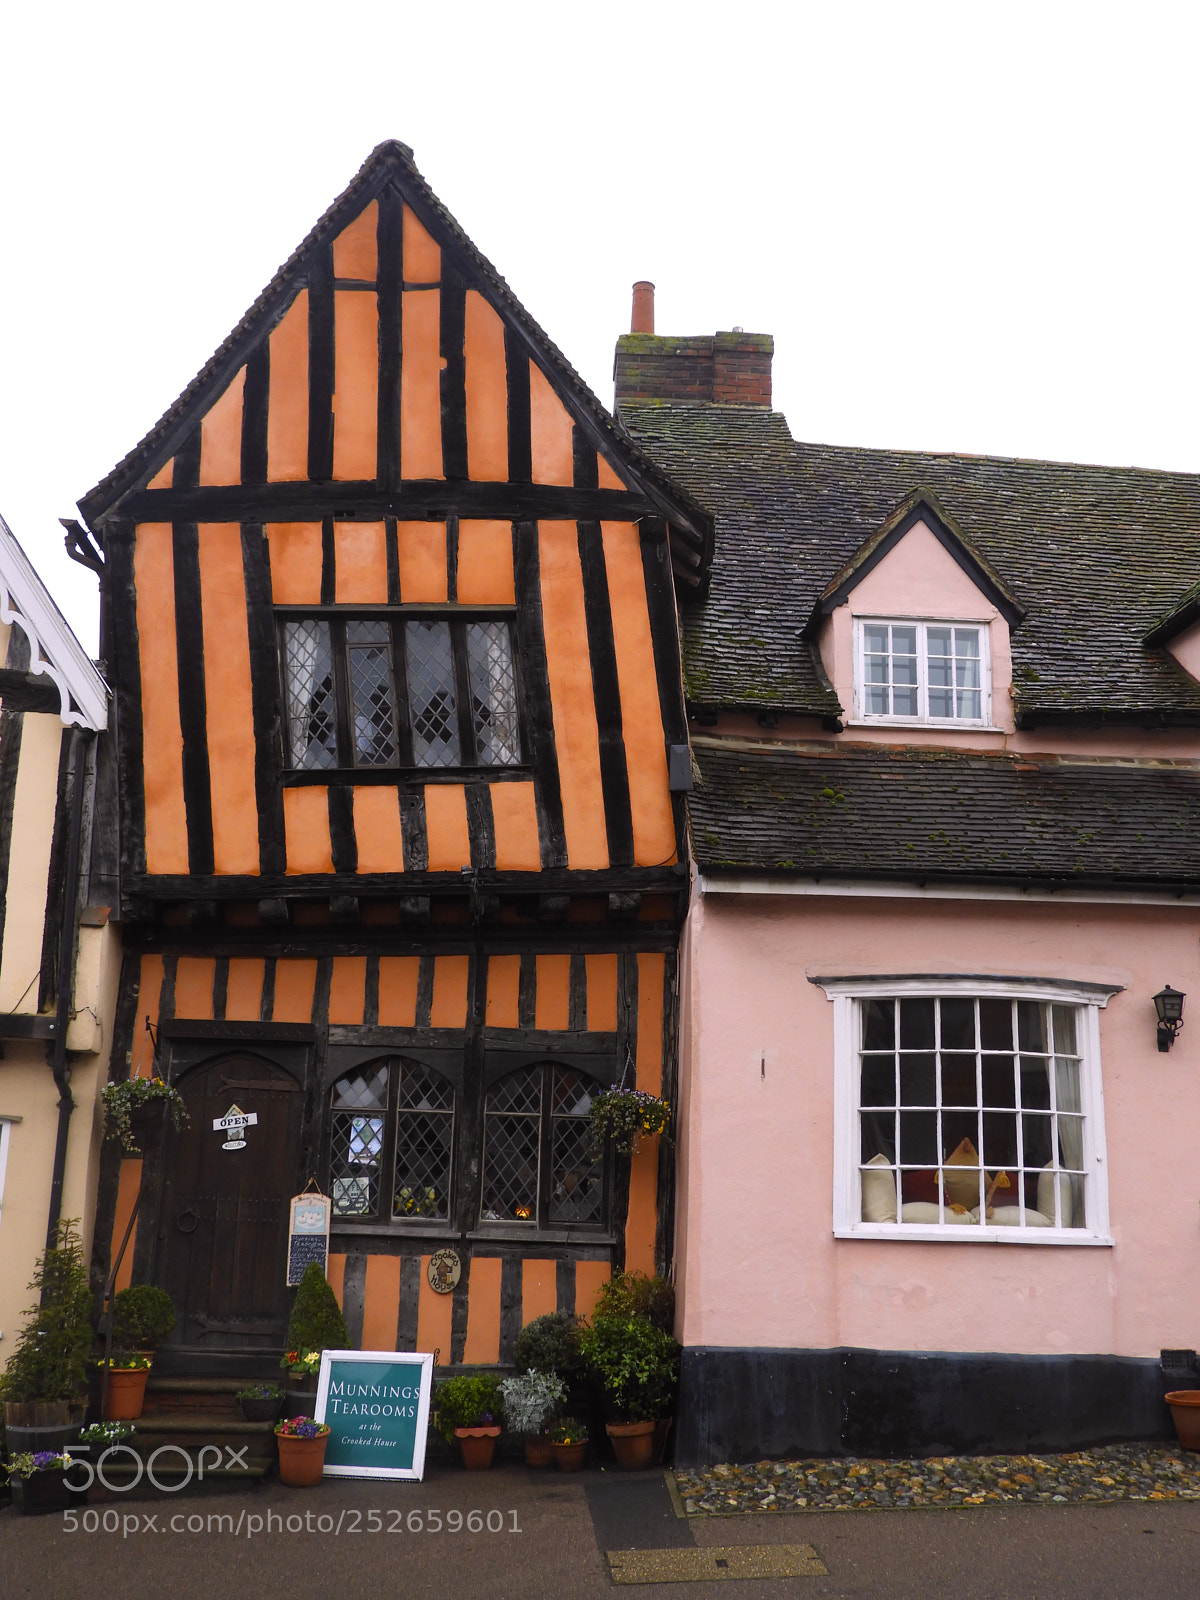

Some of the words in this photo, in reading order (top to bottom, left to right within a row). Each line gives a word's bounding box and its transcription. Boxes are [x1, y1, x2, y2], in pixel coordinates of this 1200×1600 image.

[220, 1116, 249, 1127] OPEN
[430, 1251, 459, 1267] Crooked
[430, 1274, 456, 1291] House
[329, 1380, 421, 1400] MUNNINGS
[331, 1398, 415, 1418] TEAROOMS
[369, 1422, 382, 1431] the
[341, 1436, 372, 1446] Crooked
[373, 1437, 397, 1447] House
